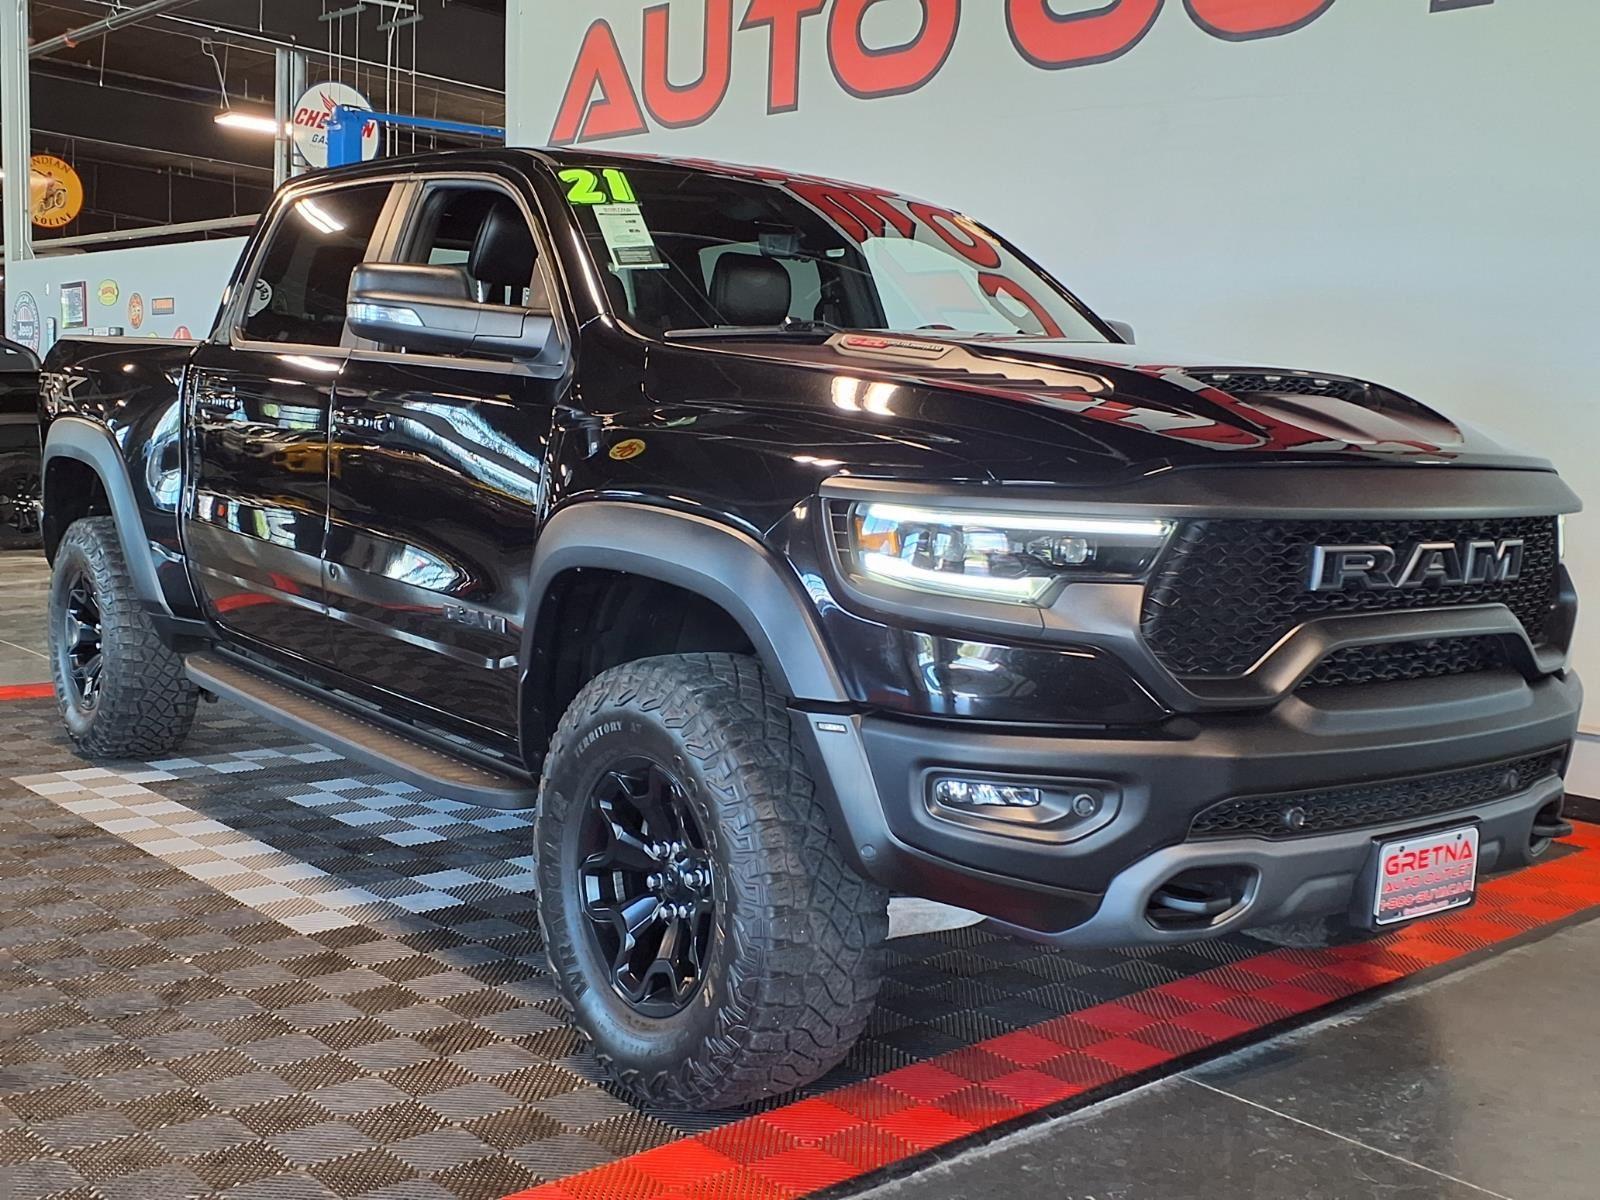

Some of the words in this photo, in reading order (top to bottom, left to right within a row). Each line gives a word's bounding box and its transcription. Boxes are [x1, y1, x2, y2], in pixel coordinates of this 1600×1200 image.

[547, 0, 962, 147] AUTO
[295, 108, 375, 138] CHEN
[31, 157, 71, 173] NDIAN
[558, 169, 635, 204] 21
[1310, 540, 1524, 591] RAM
[575, 720, 623, 758] TERRITORY
[1385, 840, 1473, 876] GRETNA
[1383, 875, 1420, 893] AUTO
[1424, 863, 1473, 885] OUTLET
